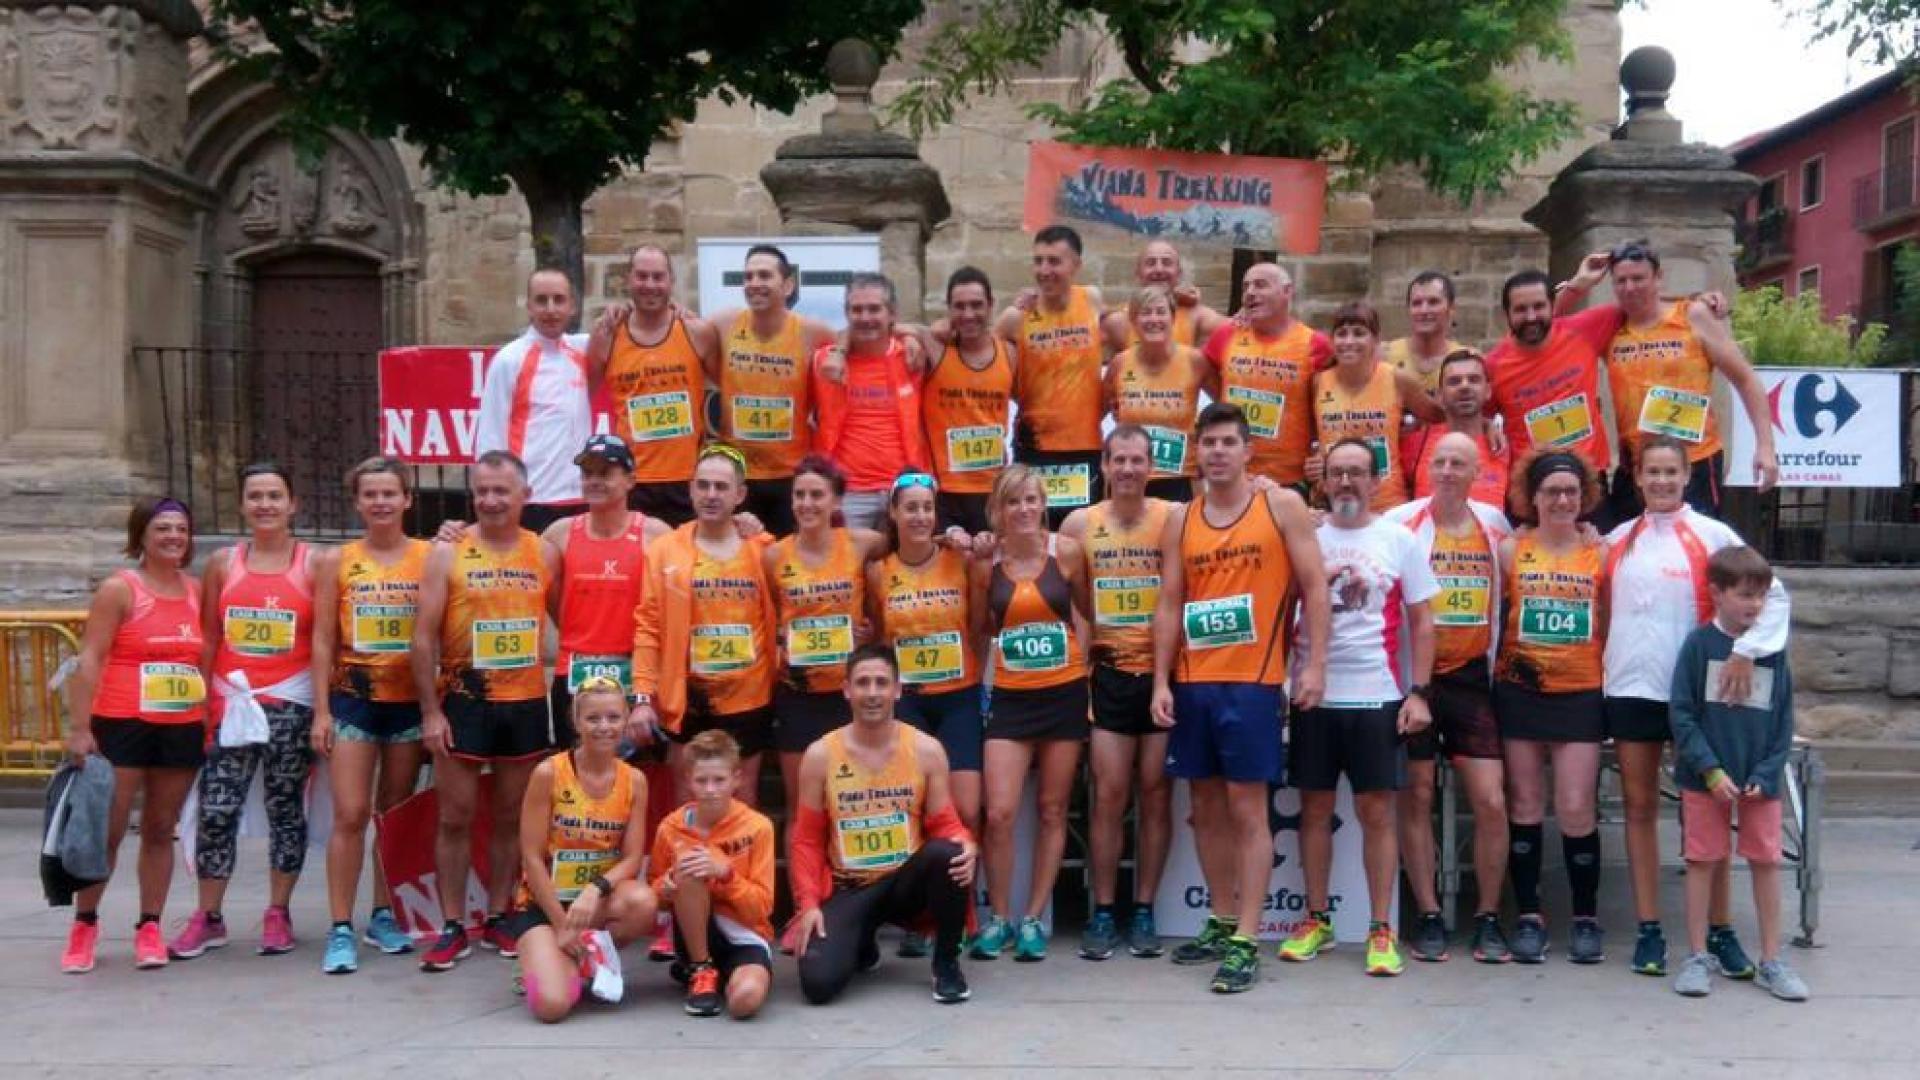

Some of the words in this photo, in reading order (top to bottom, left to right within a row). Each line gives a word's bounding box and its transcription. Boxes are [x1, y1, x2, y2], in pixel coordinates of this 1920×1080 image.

[1081, 162, 1147, 197] VIANA
[1156, 169, 1272, 207] TREKKING
[642, 406, 679, 427] 128
[749, 411, 771, 428] 41
[1667, 404, 1682, 423] 2
[1554, 416, 1566, 433] 1
[962, 440, 994, 458] 147
[1775, 449, 1863, 467] rrefour
[1114, 592, 1140, 611] 19
[1446, 591, 1473, 609] 45
[375, 620, 400, 637] 18
[1198, 611, 1238, 633] 153
[1535, 612, 1576, 632] 104
[245, 623, 271, 641] 20
[806, 631, 831, 650] 35
[494, 635, 521, 653] 63
[709, 640, 736, 658] 24
[1013, 637, 1052, 657] 106
[914, 649, 940, 668] 47
[165, 678, 189, 697] 10
[855, 830, 894, 853] 101
